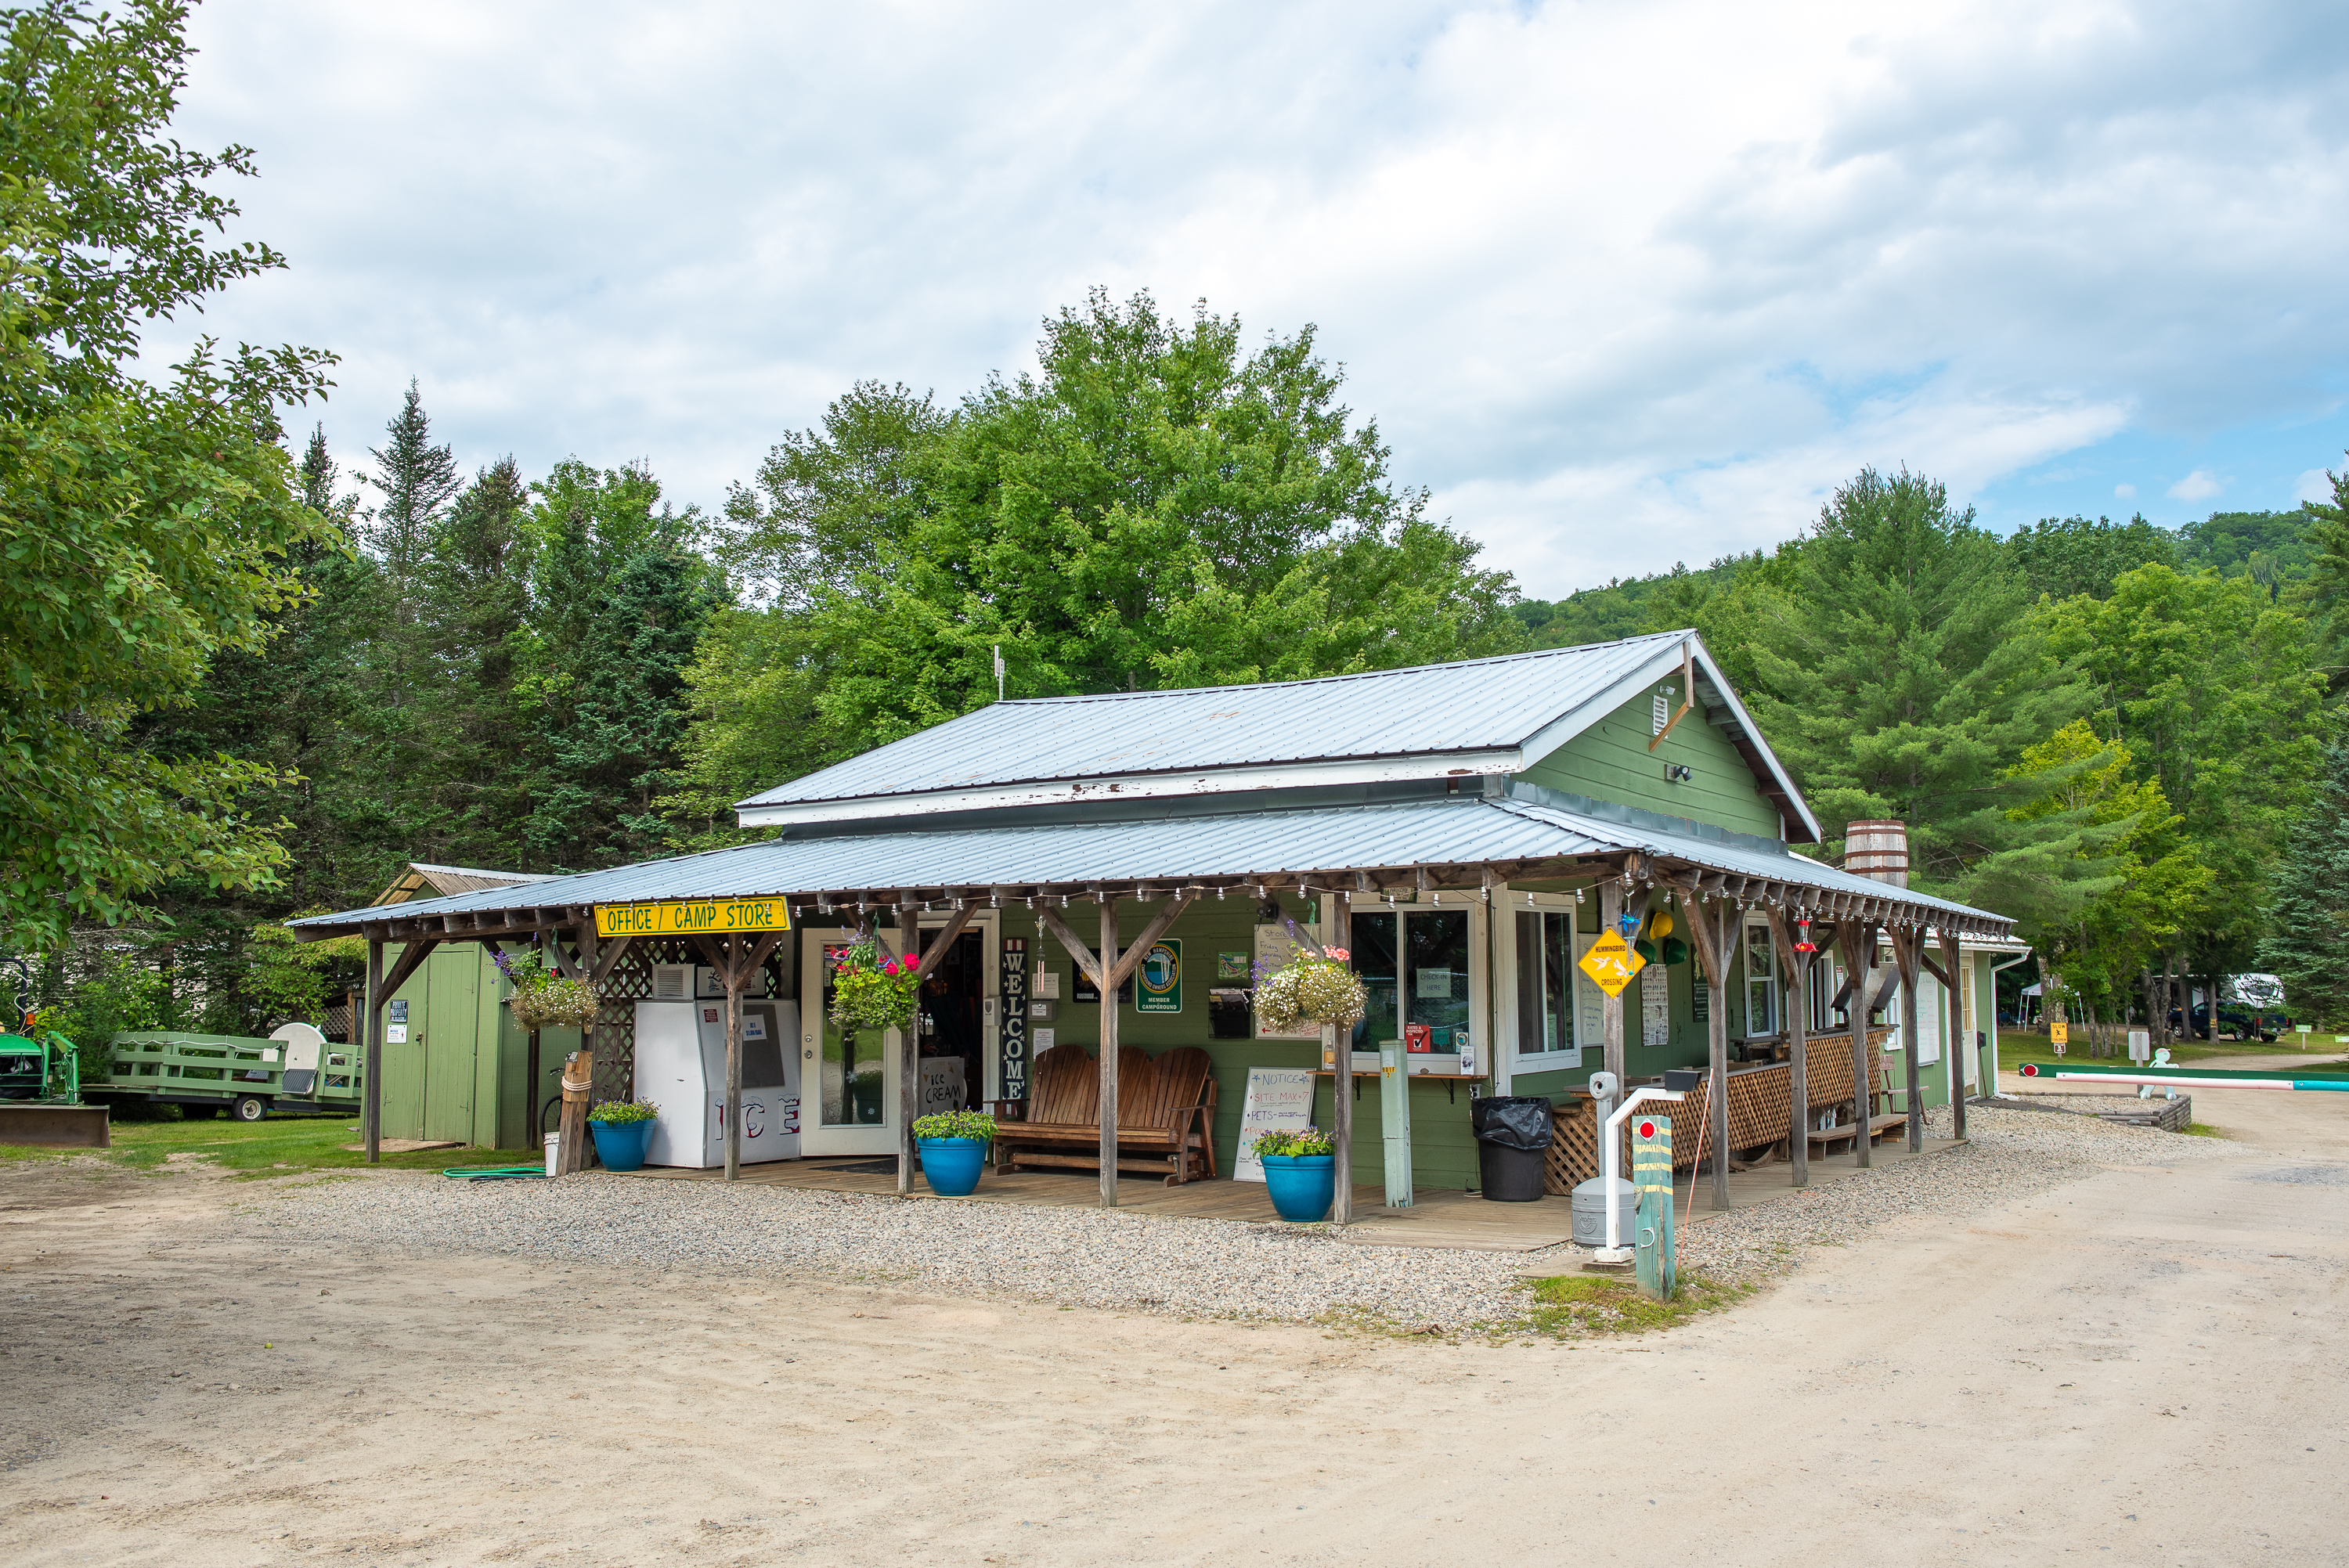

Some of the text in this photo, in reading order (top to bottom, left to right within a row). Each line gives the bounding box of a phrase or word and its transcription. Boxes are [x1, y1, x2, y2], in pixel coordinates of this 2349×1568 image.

[608, 908, 651, 931] OFFICE
[675, 906, 716, 928] CAMP
[727, 903, 772, 927] STORE
[1143, 947, 1174, 961] NEW HAMPSHIRE
[1260, 941, 1278, 952] Friday
[1141, 964, 1153, 988] CAMPGROUND
[1165, 963, 1176, 987] ASSOCIATION
[391, 1008, 407, 1017] PROPERTY
[1005, 953, 1024, 1099] WELCOME
[1262, 1073, 1298, 1086] NOTICE
[926, 1085, 961, 1104] CREAM
[1254, 1093, 1275, 1102] SITE
[714, 1094, 800, 1141] ICE
